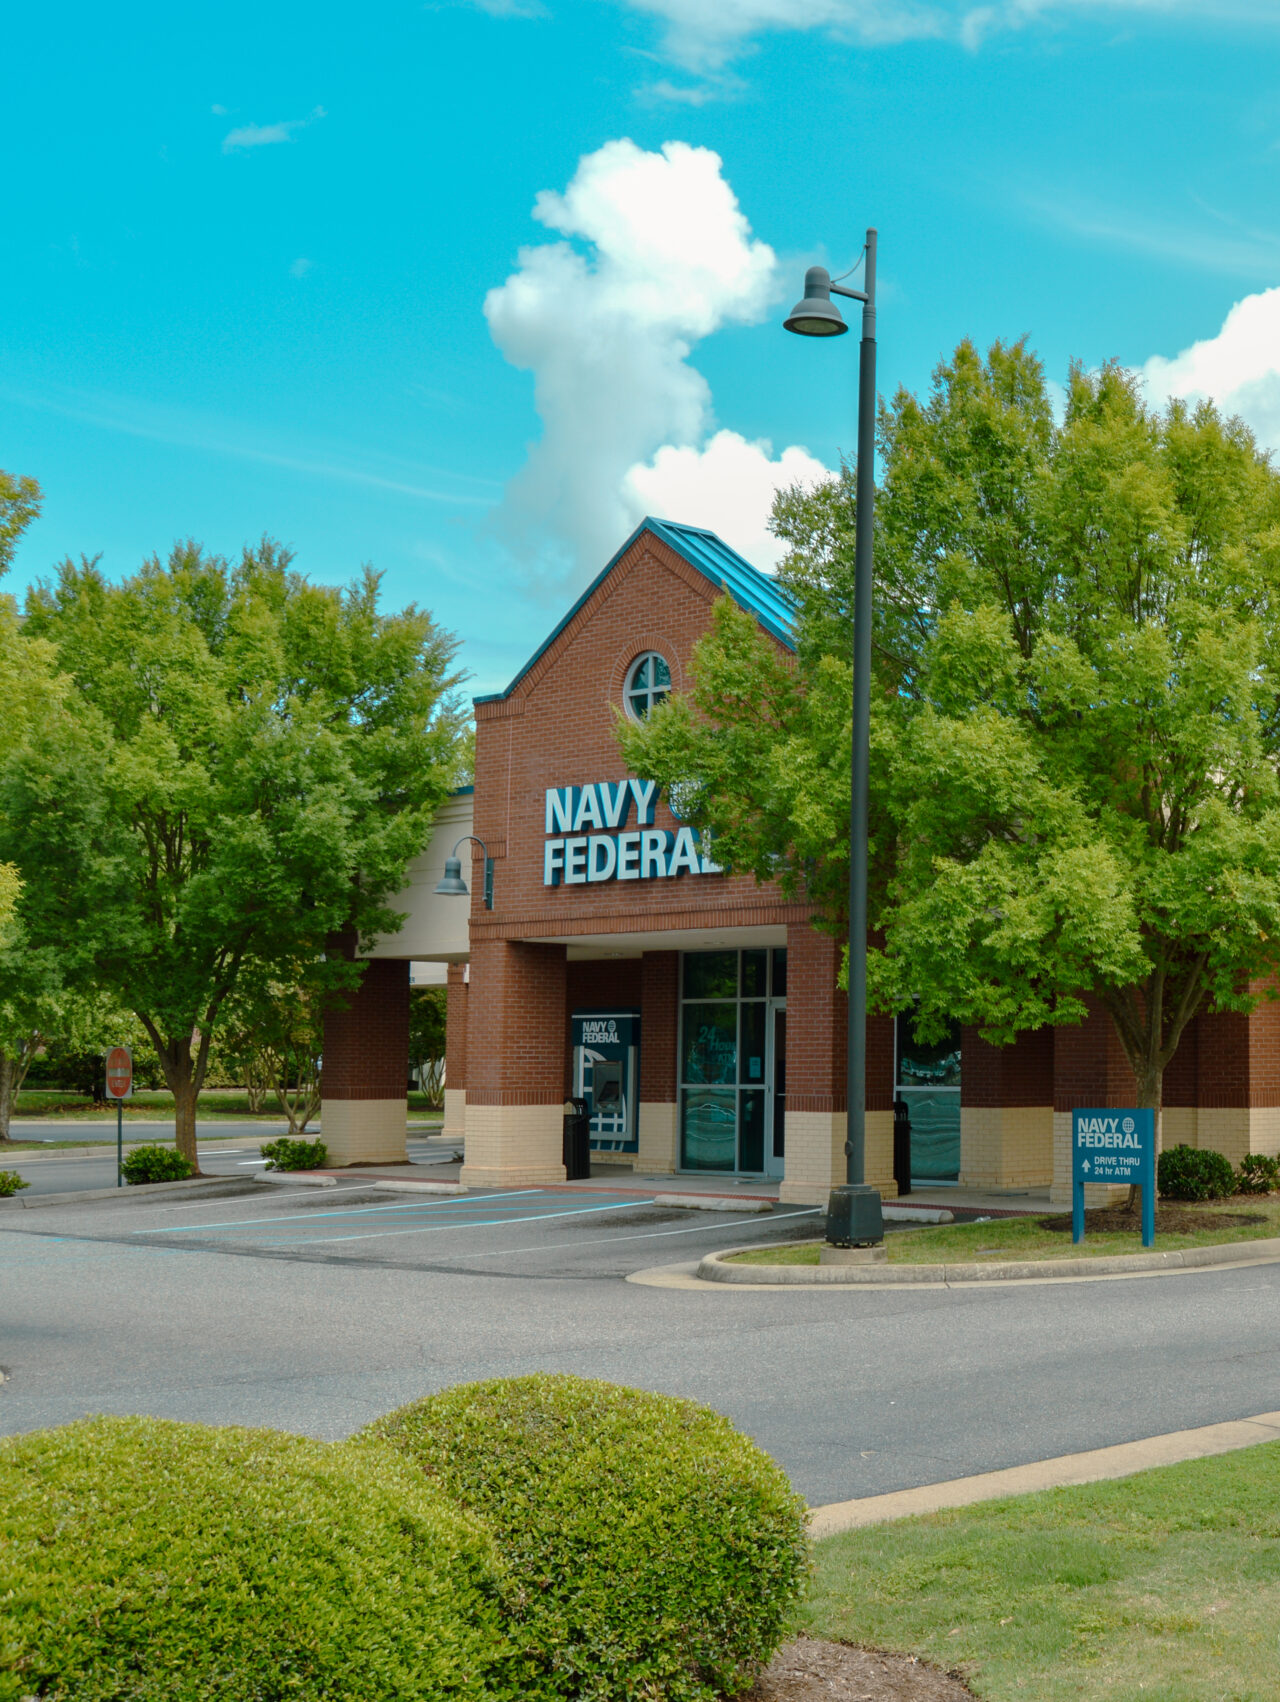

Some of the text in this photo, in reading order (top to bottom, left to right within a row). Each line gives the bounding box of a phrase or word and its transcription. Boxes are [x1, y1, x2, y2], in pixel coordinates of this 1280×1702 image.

[545, 778, 660, 834] NAVY
[543, 826, 730, 886] FEDERAL
[583, 1021, 607, 1033] NAVY
[583, 1032, 620, 1043] FEDERAL
[1078, 1118, 1119, 1133] NAVY
[1078, 1132, 1142, 1149] FEDERAL
[1094, 1156, 1140, 1166] DRIVE THRU
[1094, 1166, 1131, 1176] 24 hr ATM
